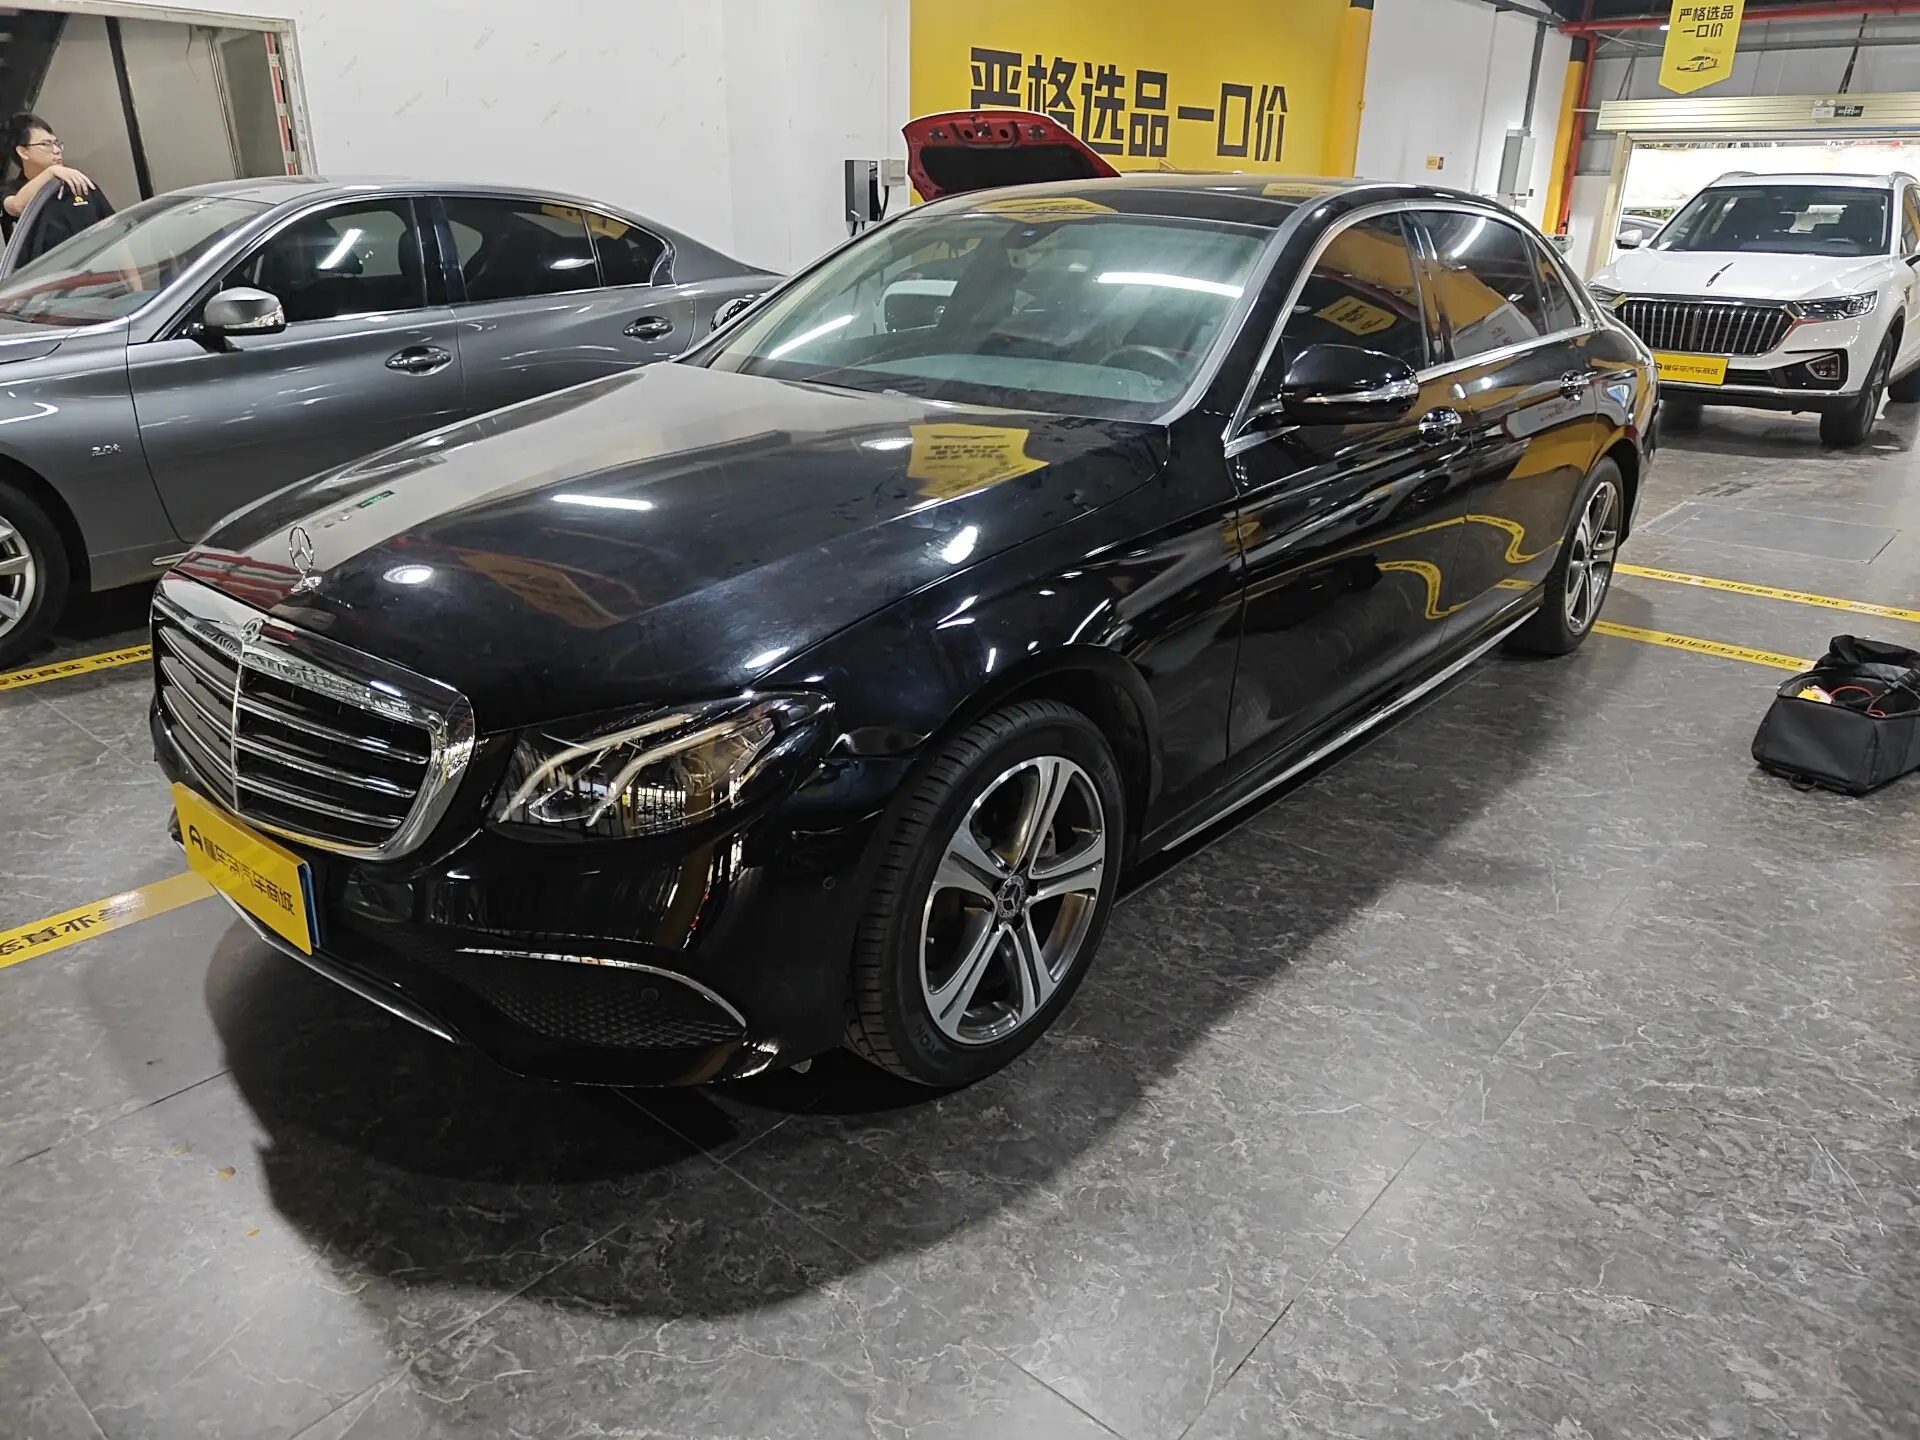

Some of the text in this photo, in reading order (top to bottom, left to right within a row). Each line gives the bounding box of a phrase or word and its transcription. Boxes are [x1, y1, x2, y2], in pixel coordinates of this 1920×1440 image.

[1678, 5, 1734, 22] 严格选品
[1682, 22, 1723, 37] 一口价
[971, 47, 1288, 162] 严格选品一口价
